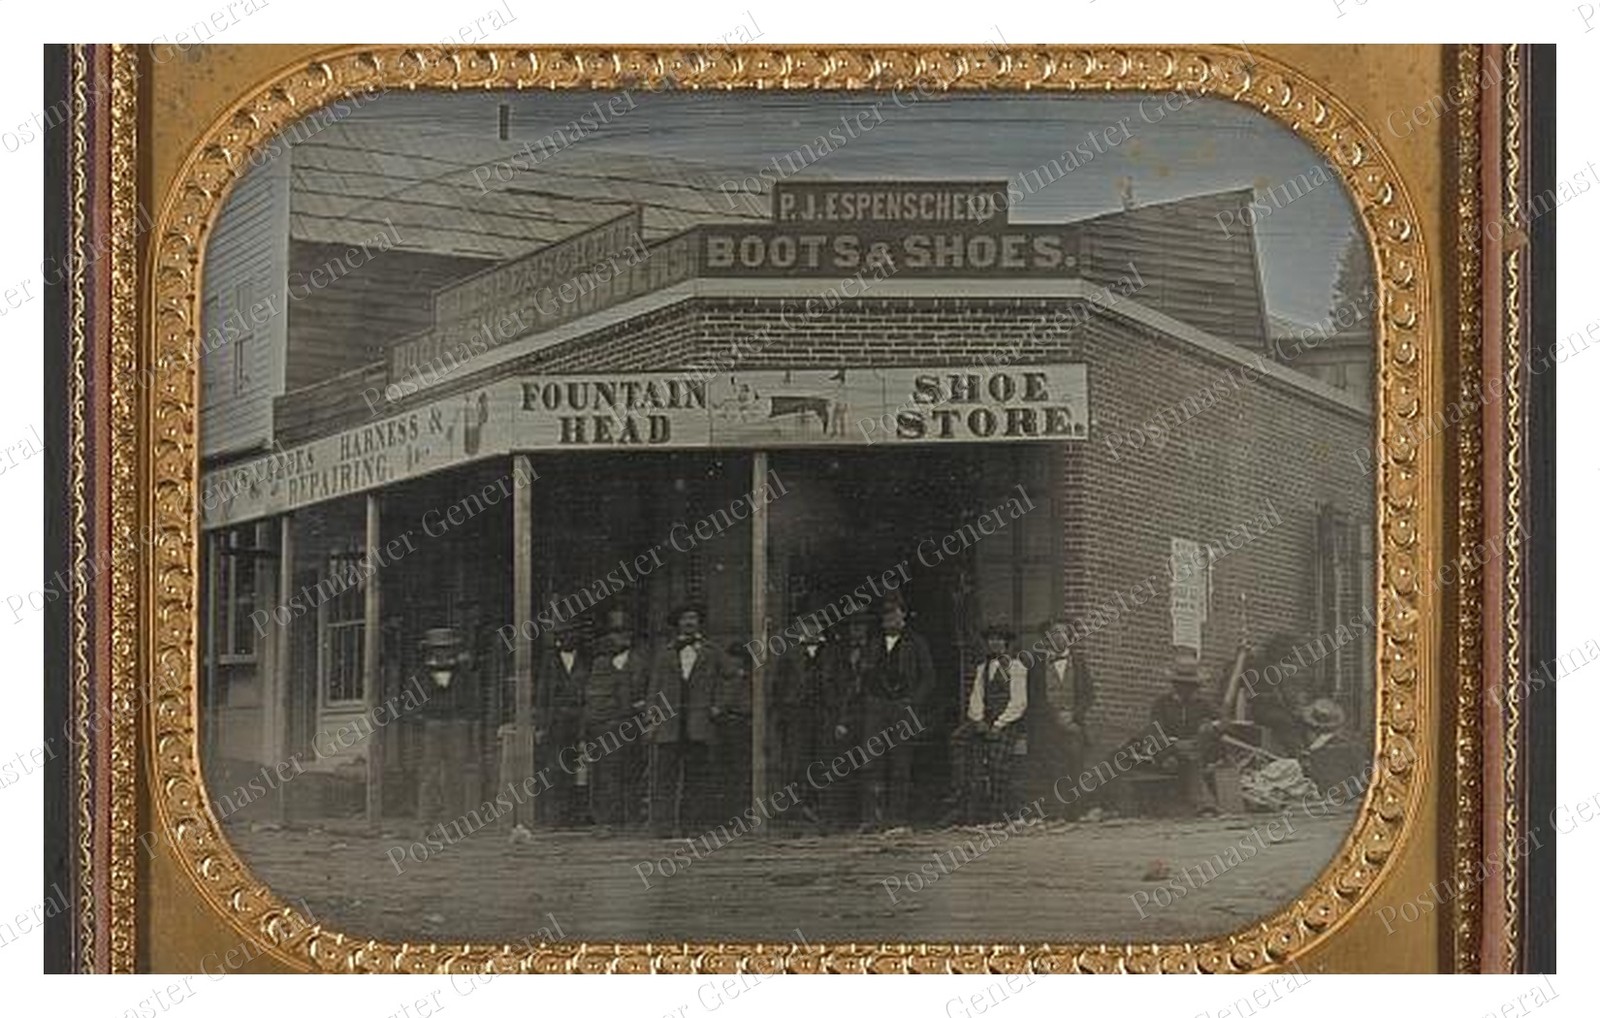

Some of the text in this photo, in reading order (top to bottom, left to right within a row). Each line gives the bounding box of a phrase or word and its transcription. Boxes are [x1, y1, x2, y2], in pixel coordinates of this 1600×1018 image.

[520, 379, 708, 411] FOUNTAIN
[913, 372, 1050, 404] SHOE
[340, 413, 419, 461] HARNESS
[558, 414, 671, 445] HEAD
